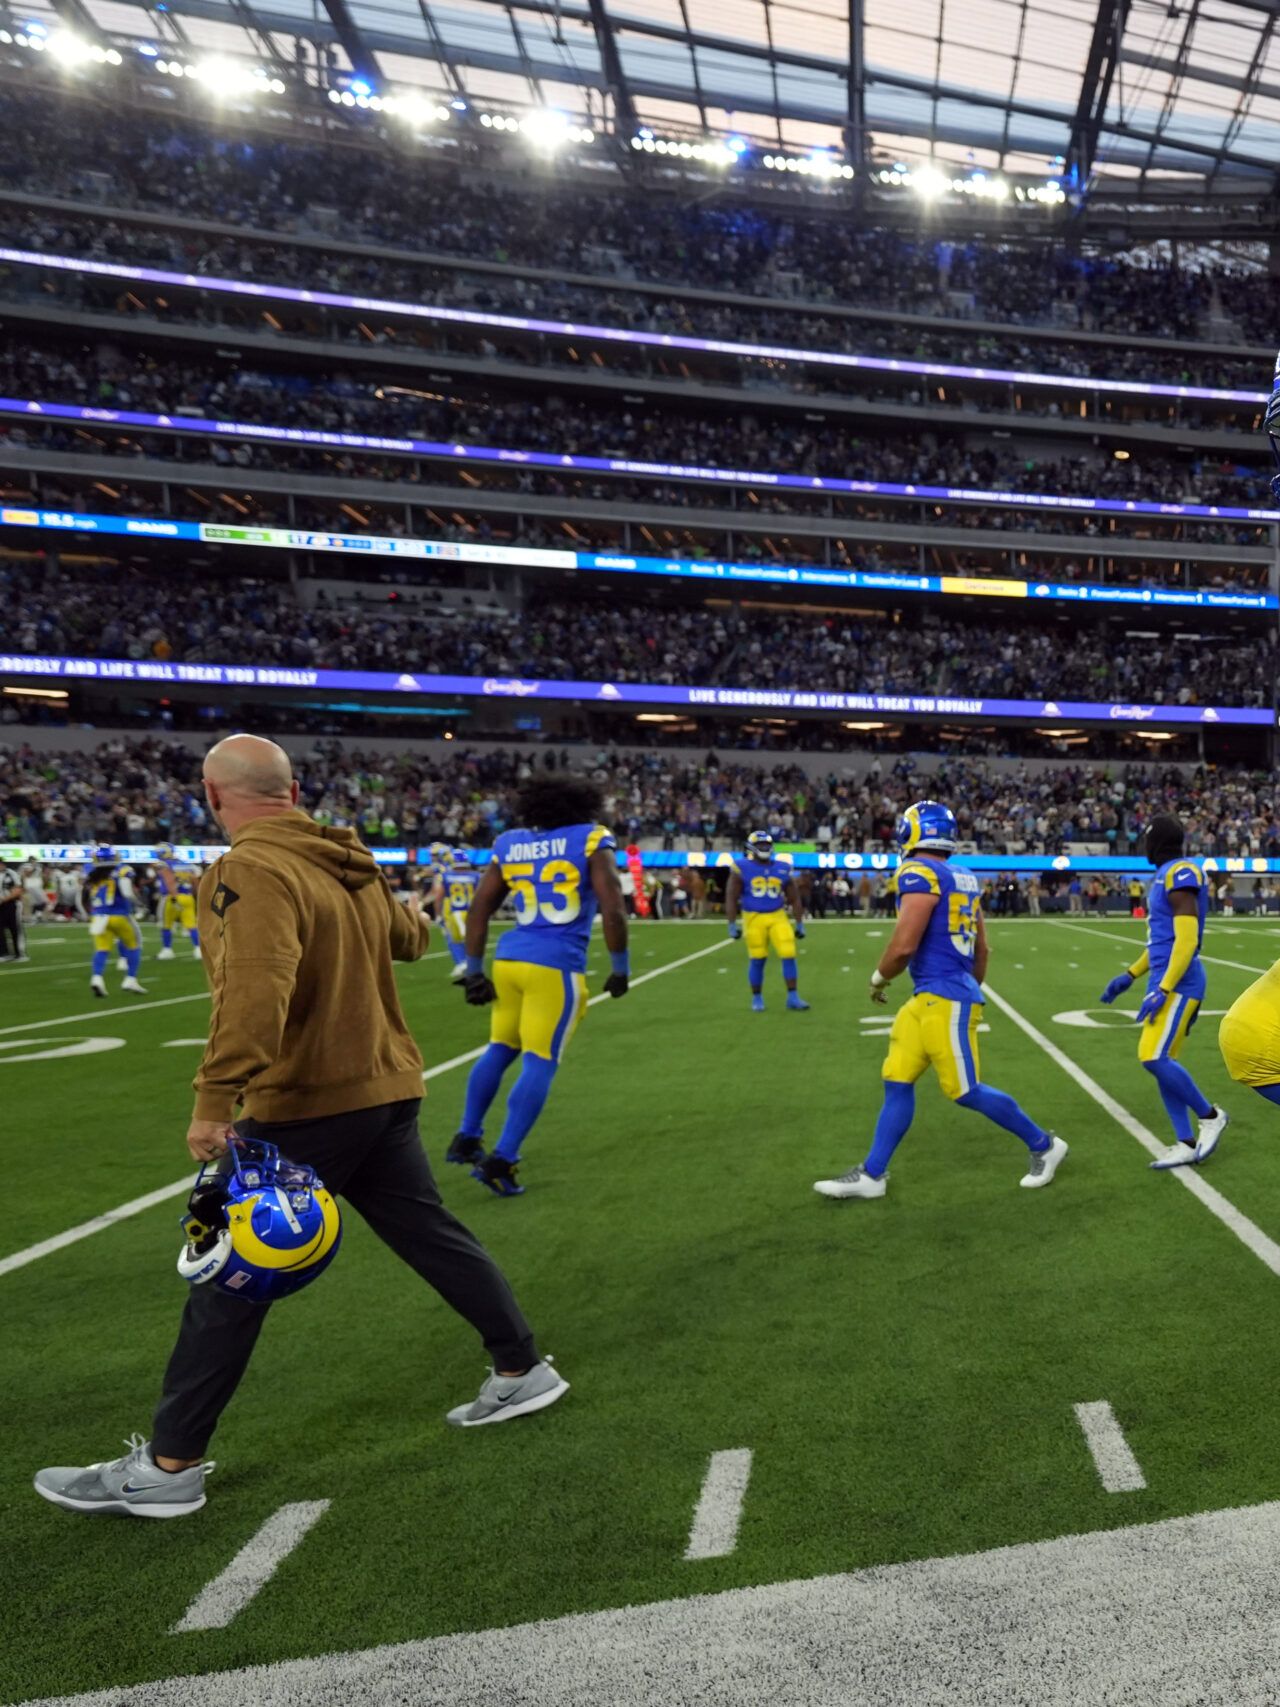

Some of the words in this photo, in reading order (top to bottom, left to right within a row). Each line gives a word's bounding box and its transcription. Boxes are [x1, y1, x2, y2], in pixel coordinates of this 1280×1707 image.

[0, 657, 60, 673] ROUSLY
[64, 660, 97, 675] AND
[100, 662, 134, 677] LIFE
[137, 664, 174, 679] WILL
[177, 665, 222, 681] TREAT
[225, 667, 255, 682] YOU
[257, 669, 317, 685] ROYALLY
[689, 690, 716, 702] LIVE
[718, 690, 791, 705] GENEROUSLY
[793, 694, 817, 707] AND
[819, 695, 845, 708] LIFE
[846, 696, 874, 709] WILL
[877, 697, 910, 711] TREAT
[912, 698, 935, 712] YOU
[937, 699, 982, 713] ROYALLY
[505, 840, 550, 863] JONES
[551, 838, 567, 856] IV
[501, 859, 581, 926] 53
